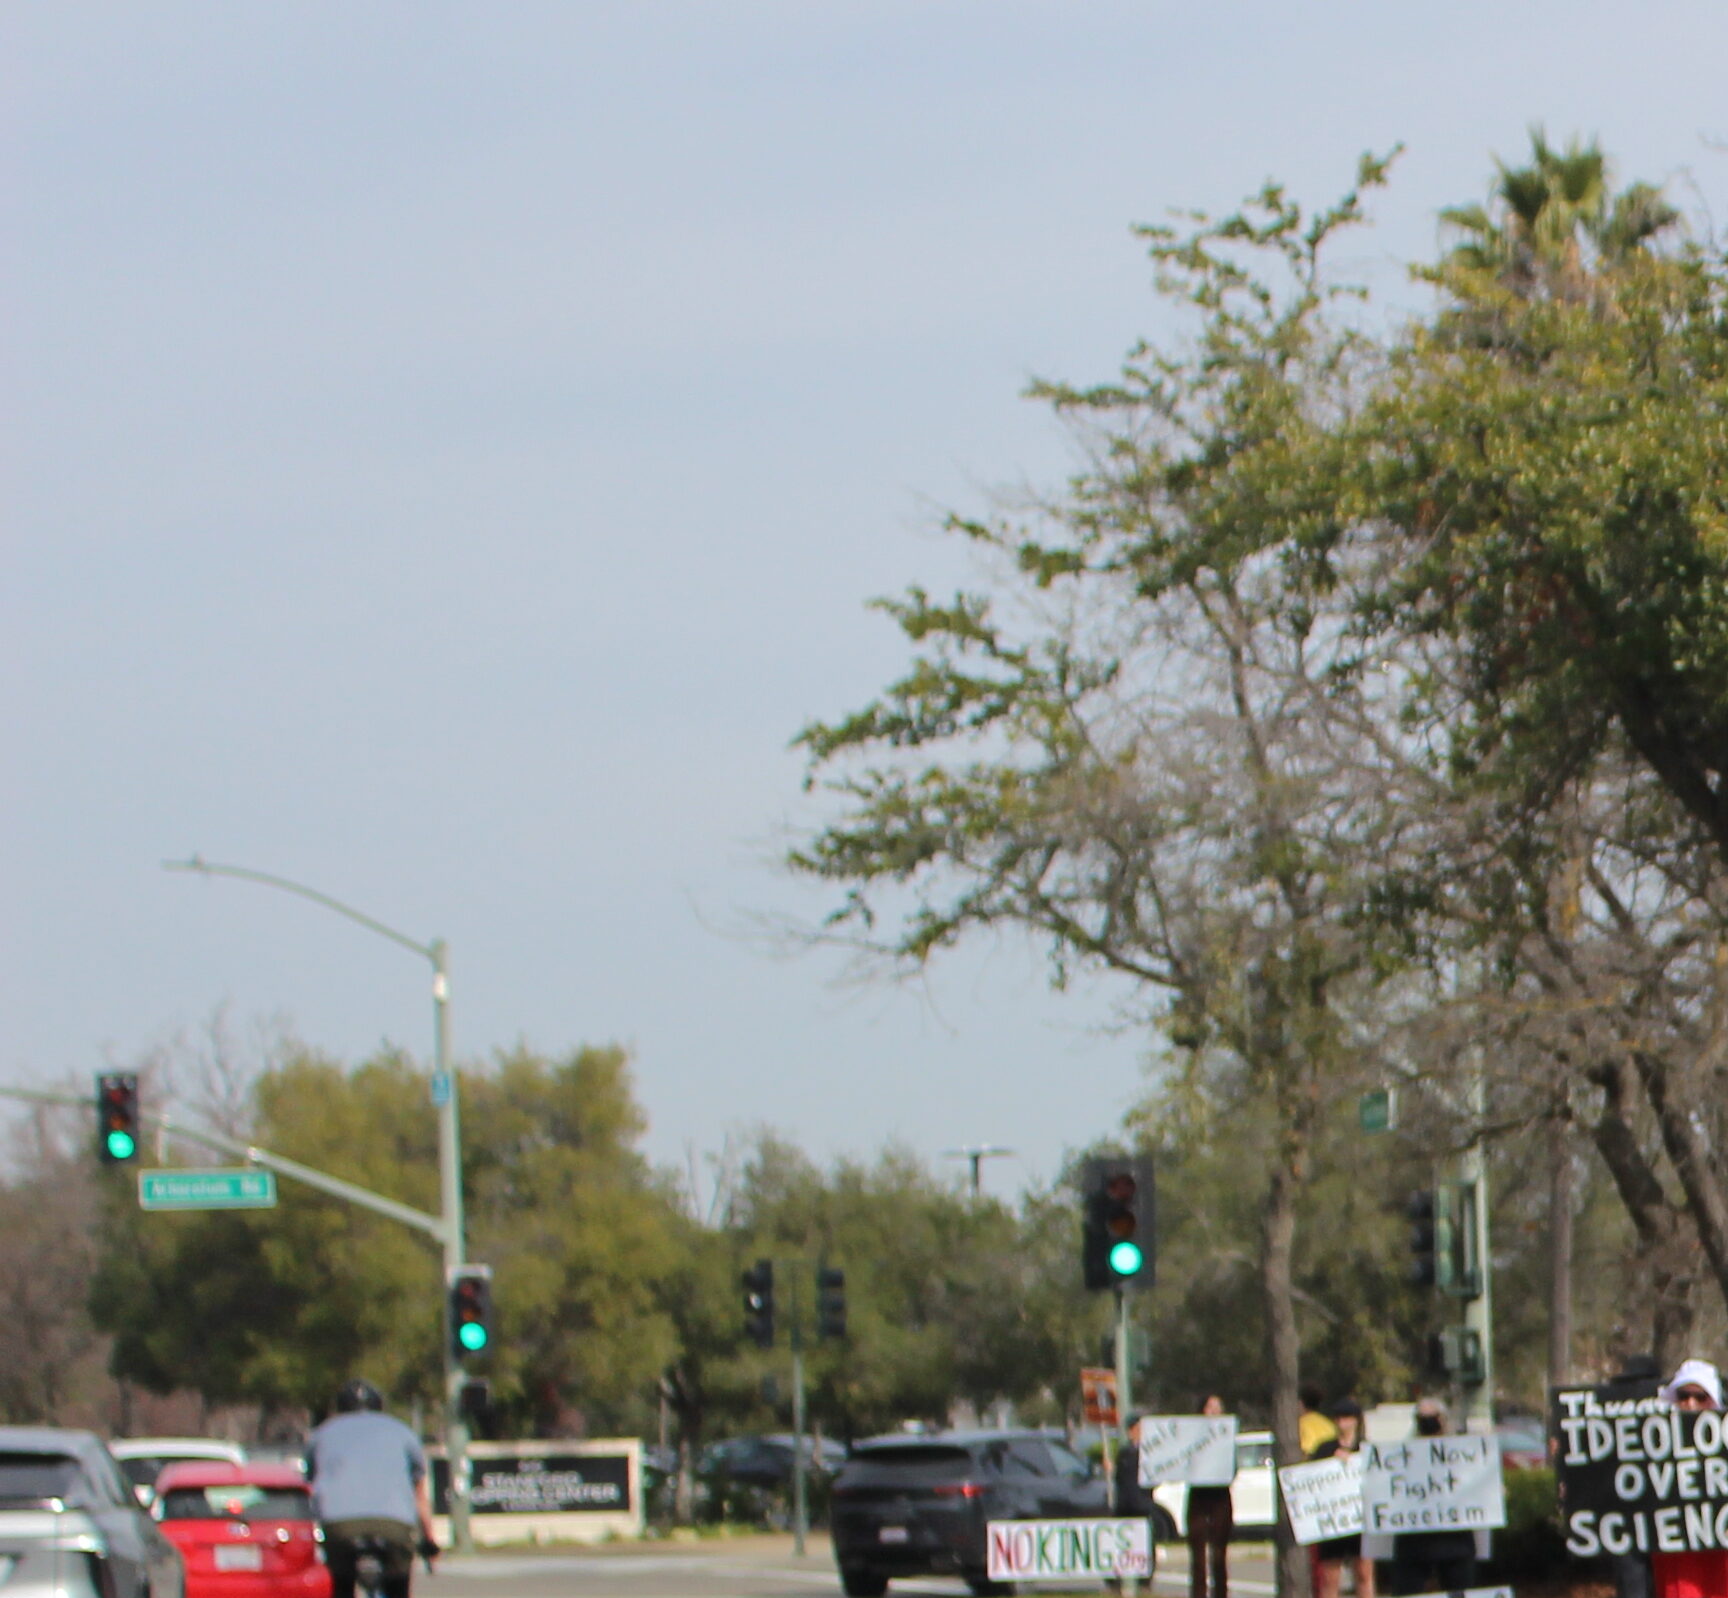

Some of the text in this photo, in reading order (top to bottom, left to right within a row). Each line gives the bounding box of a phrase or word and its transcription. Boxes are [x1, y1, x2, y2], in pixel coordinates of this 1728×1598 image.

[1367, 1438, 1487, 1471] Act Now!
[1390, 1472, 1458, 1500] Fight
[1373, 1503, 1485, 1529] Fascism
